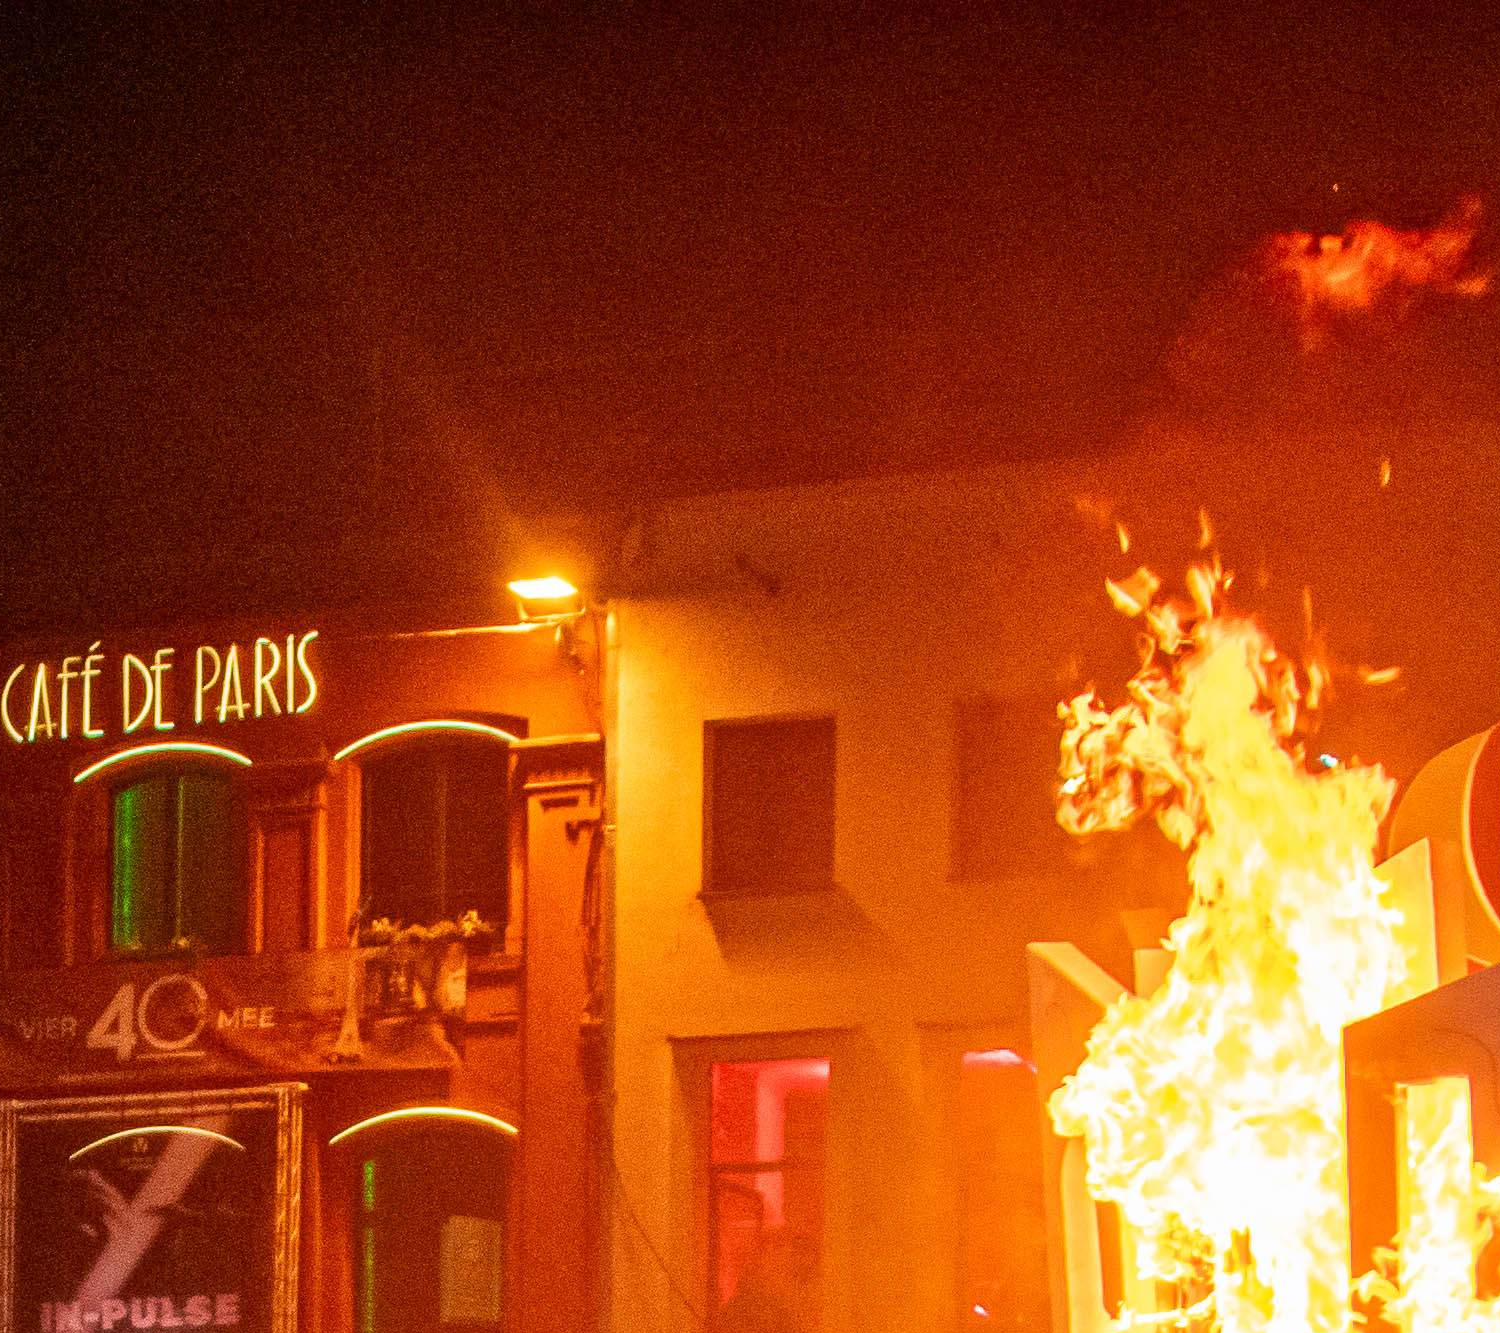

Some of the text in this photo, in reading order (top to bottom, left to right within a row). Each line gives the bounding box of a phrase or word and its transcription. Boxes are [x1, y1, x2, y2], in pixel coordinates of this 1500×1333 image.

[1, 630, 319, 743] CAFÉ DE PARIS
[86, 973, 209, 1062] 40
